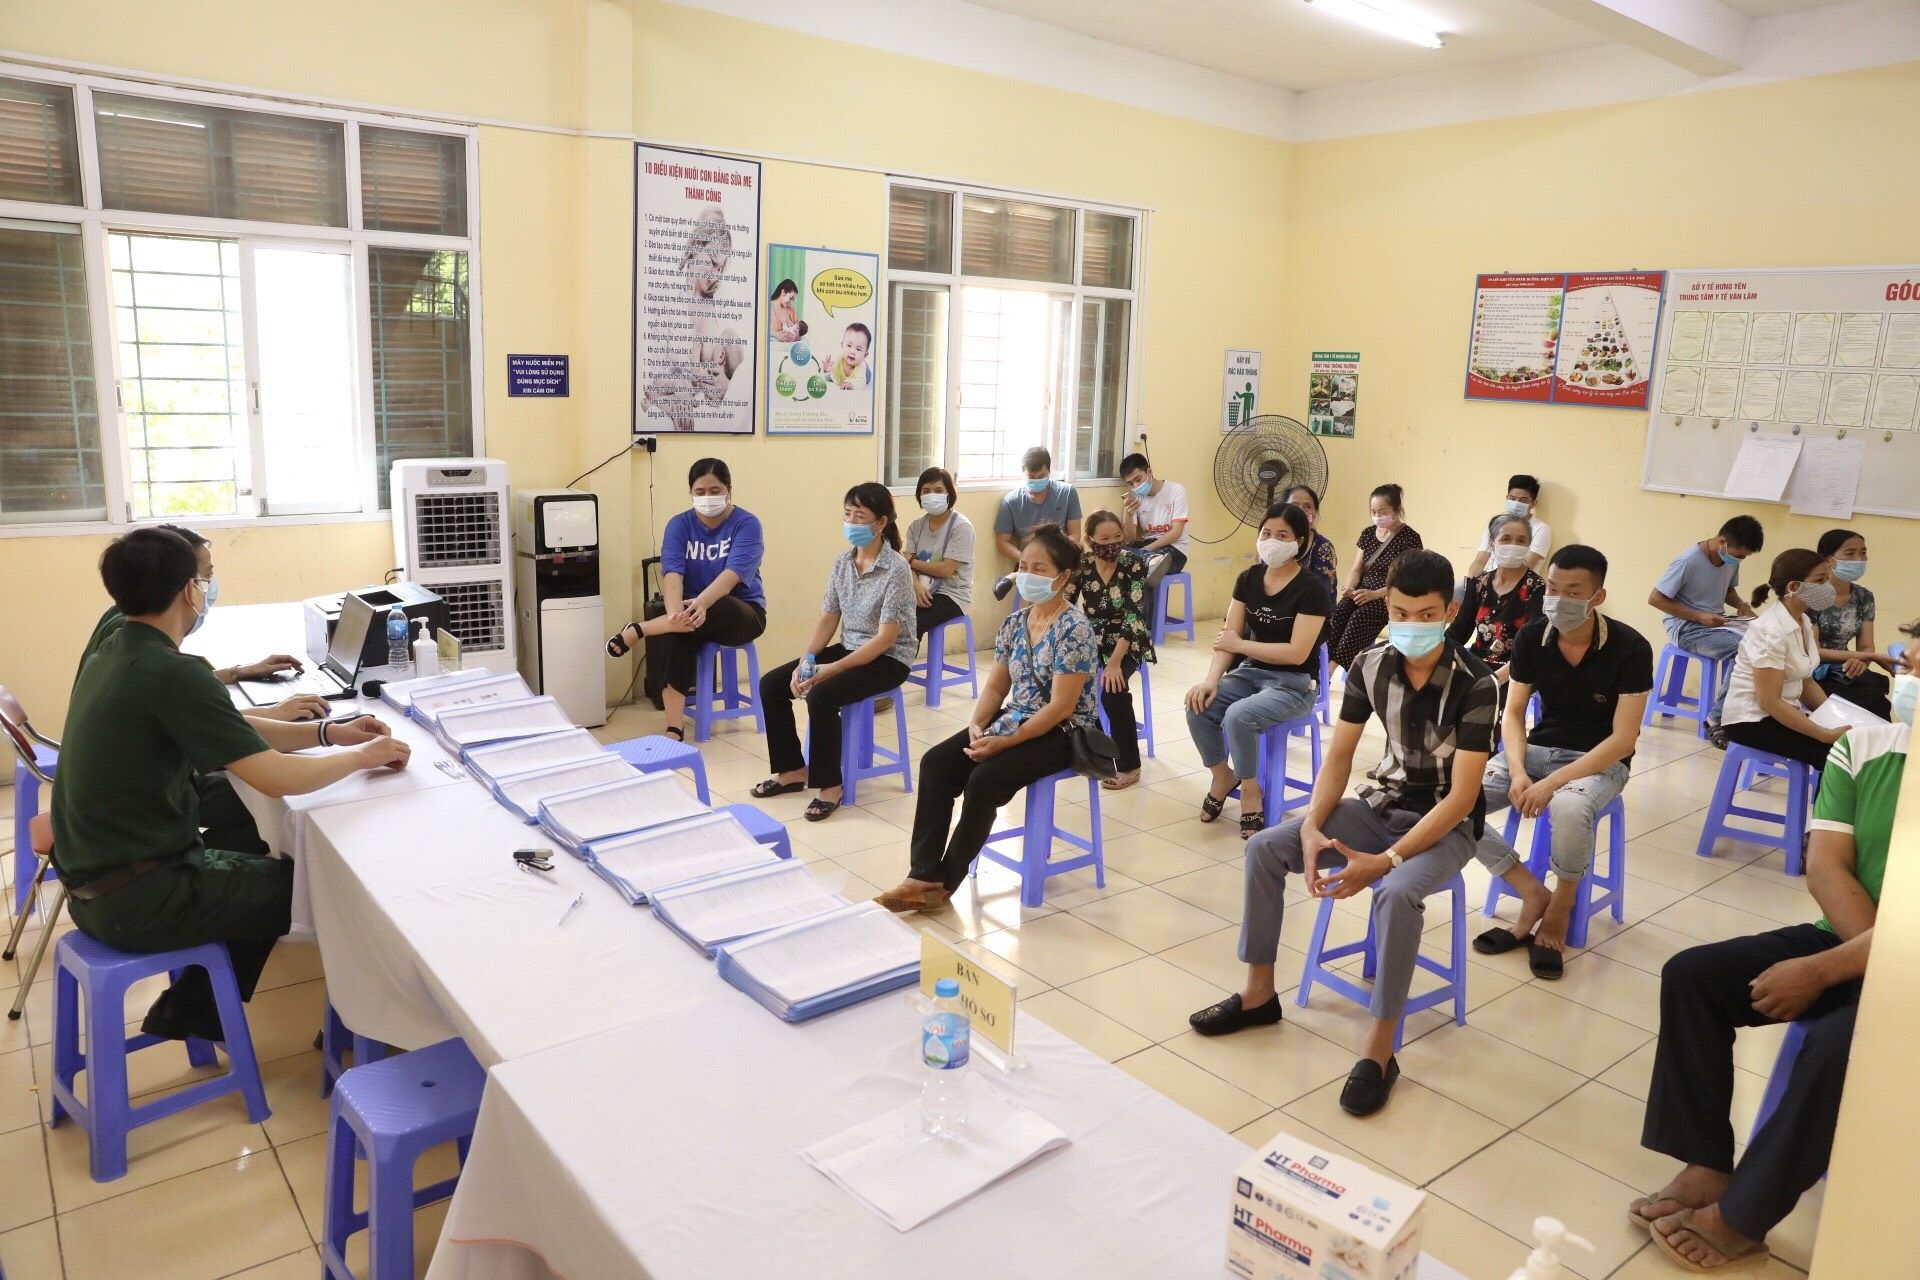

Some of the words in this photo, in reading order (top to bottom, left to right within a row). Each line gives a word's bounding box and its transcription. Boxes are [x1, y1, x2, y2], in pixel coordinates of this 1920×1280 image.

[645, 162, 652, 174] 10
[700, 170, 712, 182] CON
[686, 537, 731, 560] NICE
[1270, 1150, 1292, 1164] HT
[1290, 1162, 1346, 1194] Pharma
[1234, 1204, 1253, 1223] HT
[1256, 1217, 1312, 1256] Pharma
